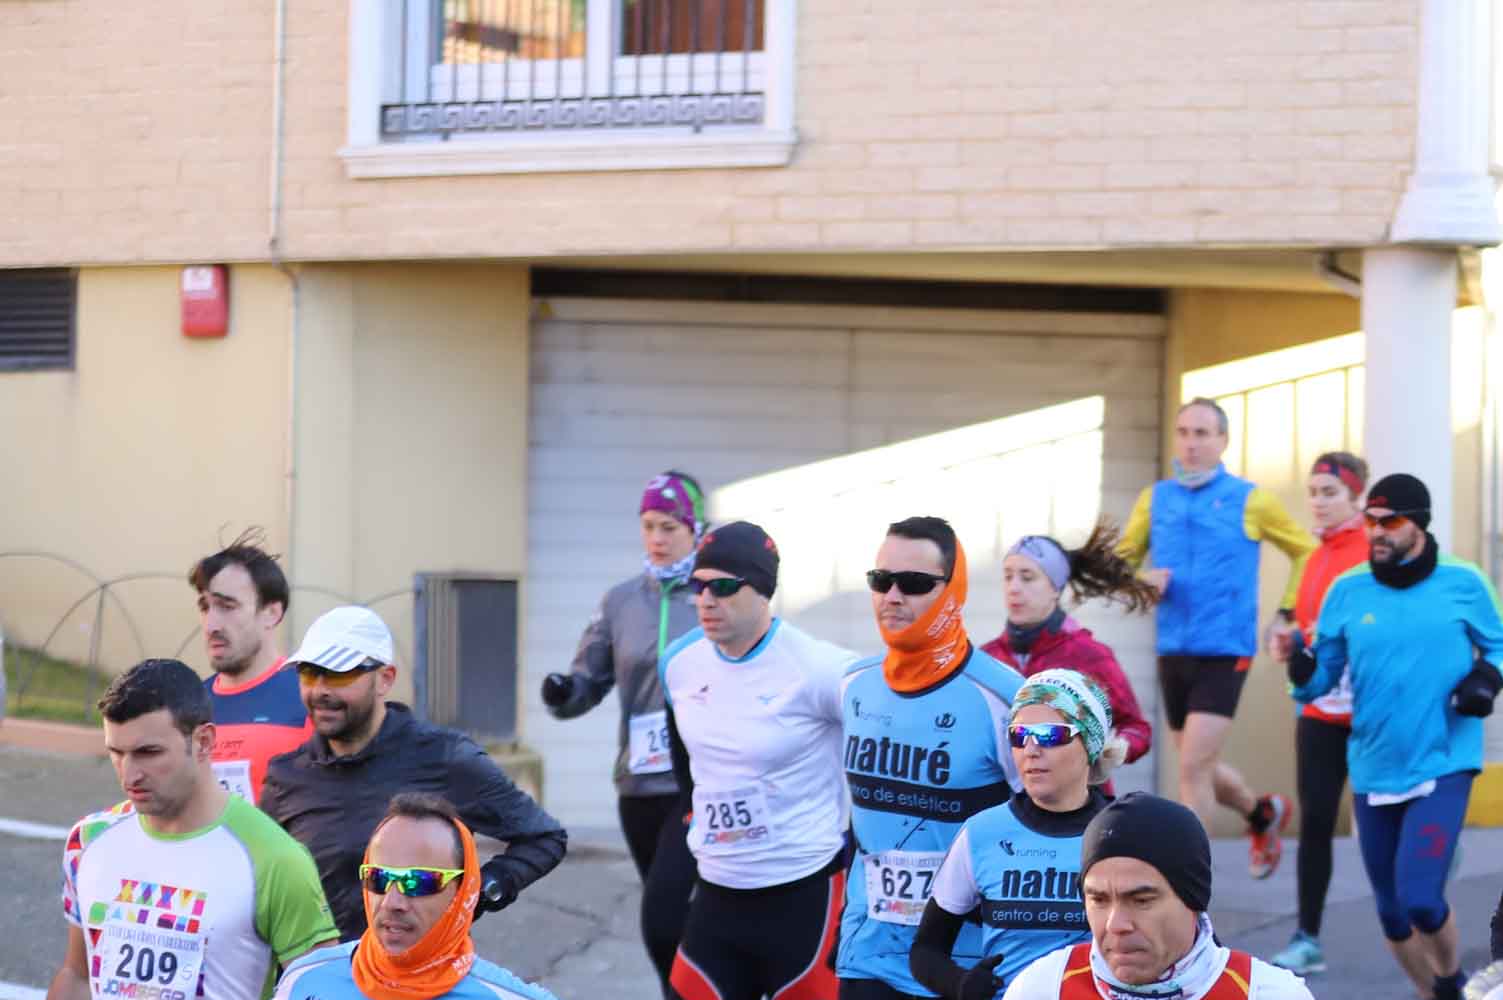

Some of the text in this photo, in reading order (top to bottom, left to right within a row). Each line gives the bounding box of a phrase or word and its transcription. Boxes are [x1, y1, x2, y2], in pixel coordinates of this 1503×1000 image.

[844, 734, 950, 786] naturé
[873, 784, 894, 802] de
[706, 800, 752, 829] 285
[1015, 847, 1056, 858] running
[881, 867, 934, 900] 627
[1002, 867, 1082, 899] natu
[992, 909, 1033, 922] centro
[1037, 908, 1058, 922] de
[115, 943, 178, 985] 209
